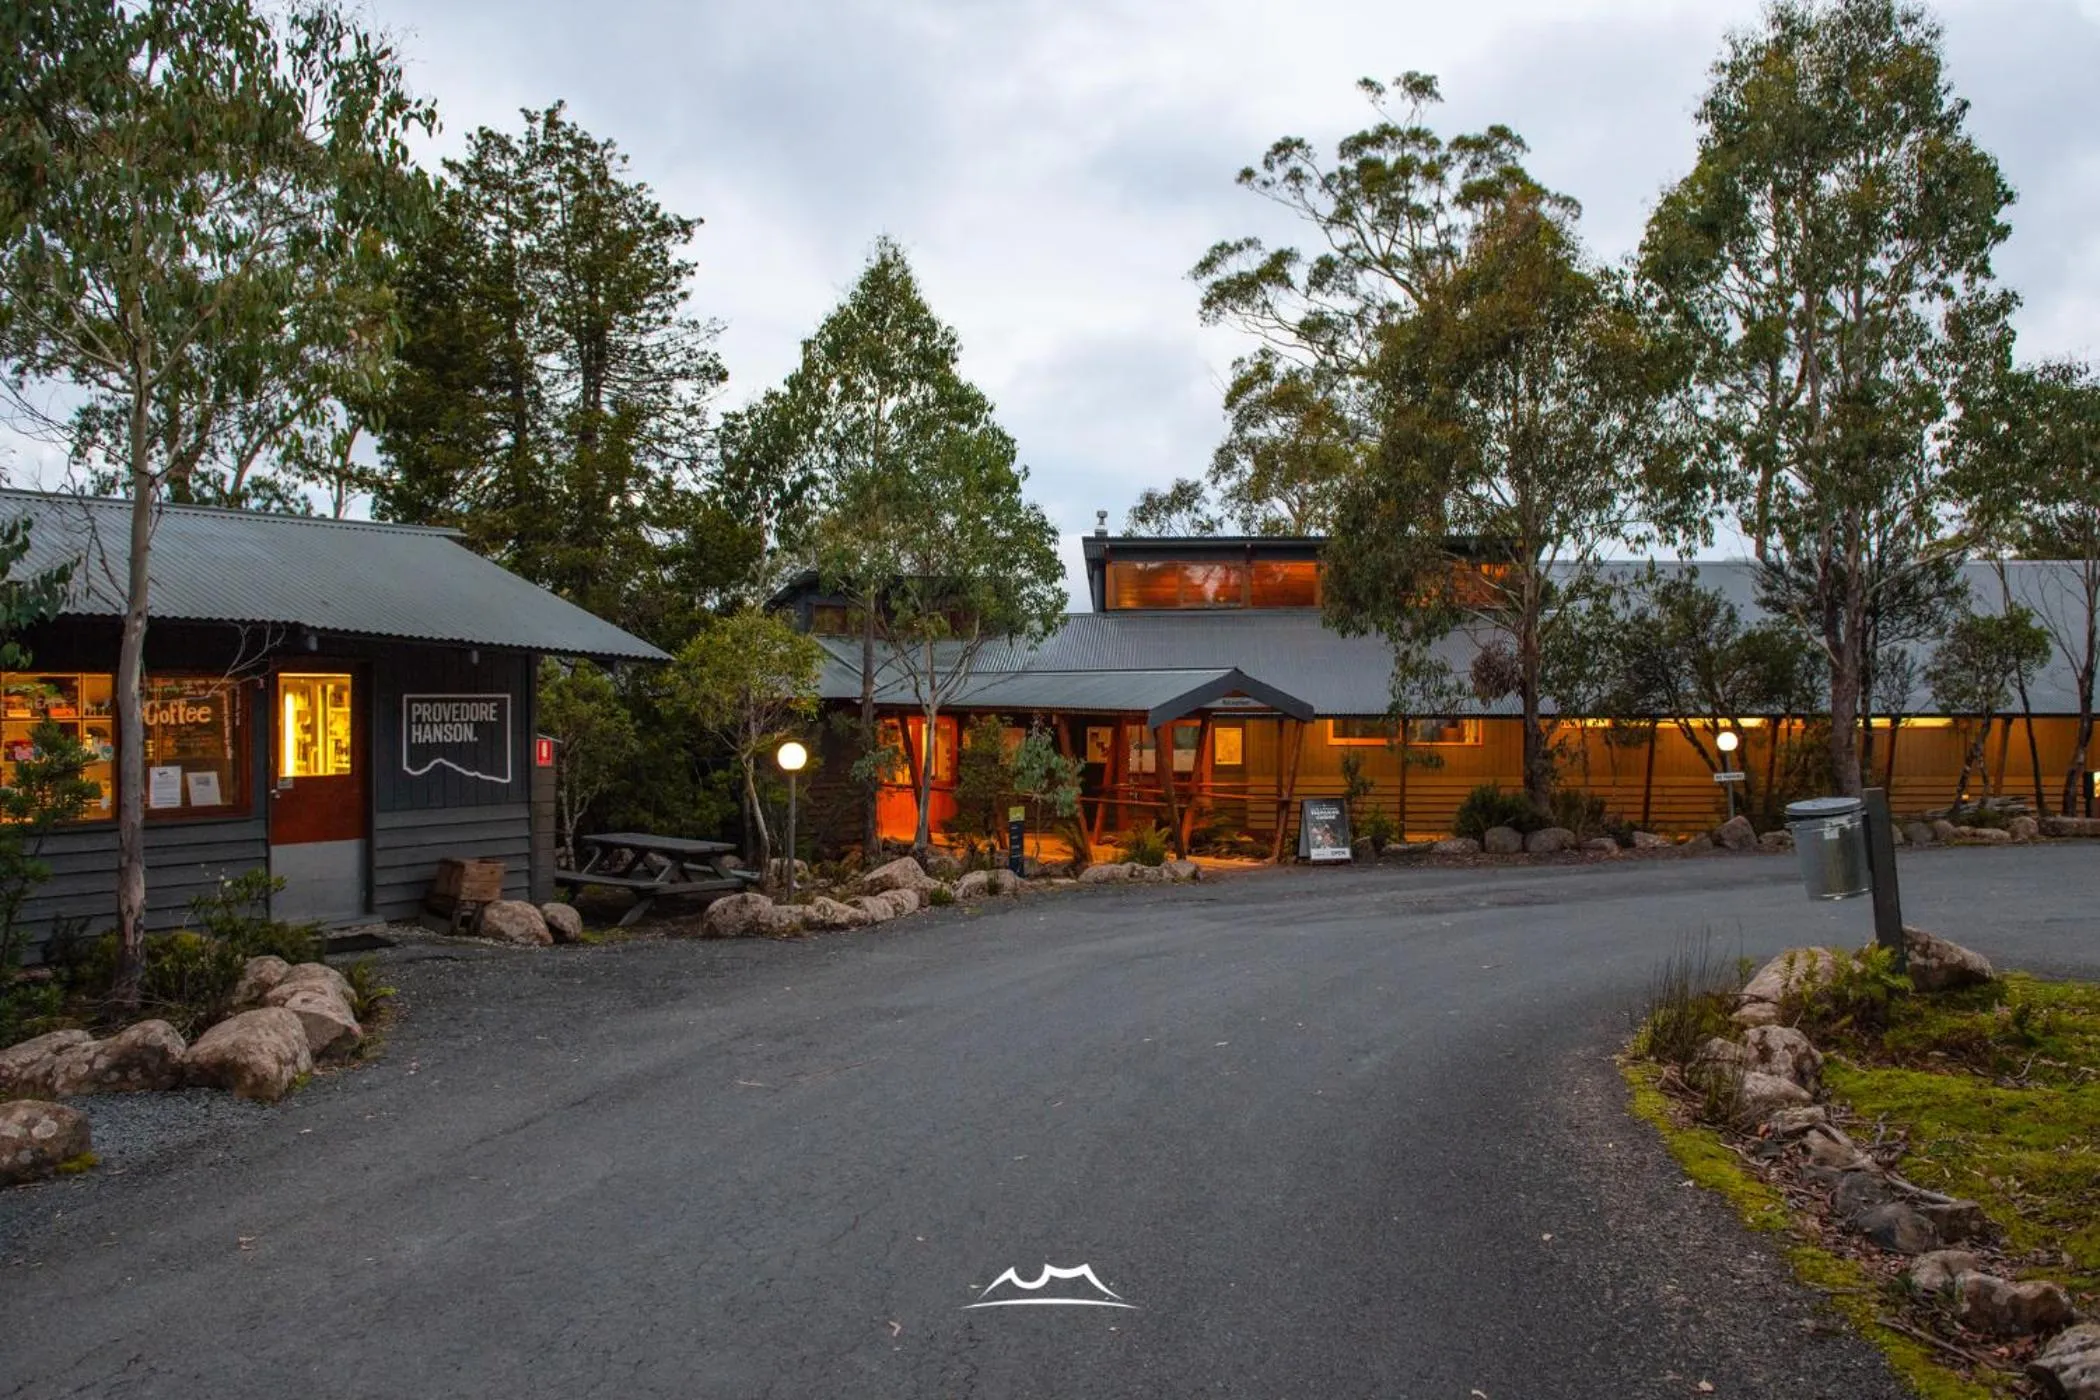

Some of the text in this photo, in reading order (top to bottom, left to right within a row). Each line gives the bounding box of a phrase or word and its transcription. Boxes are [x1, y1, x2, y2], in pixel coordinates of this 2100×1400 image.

[143, 699, 212, 726] Coffee
[411, 702, 498, 722] PROVEDORE
[411, 723, 479, 744] HANSON.
